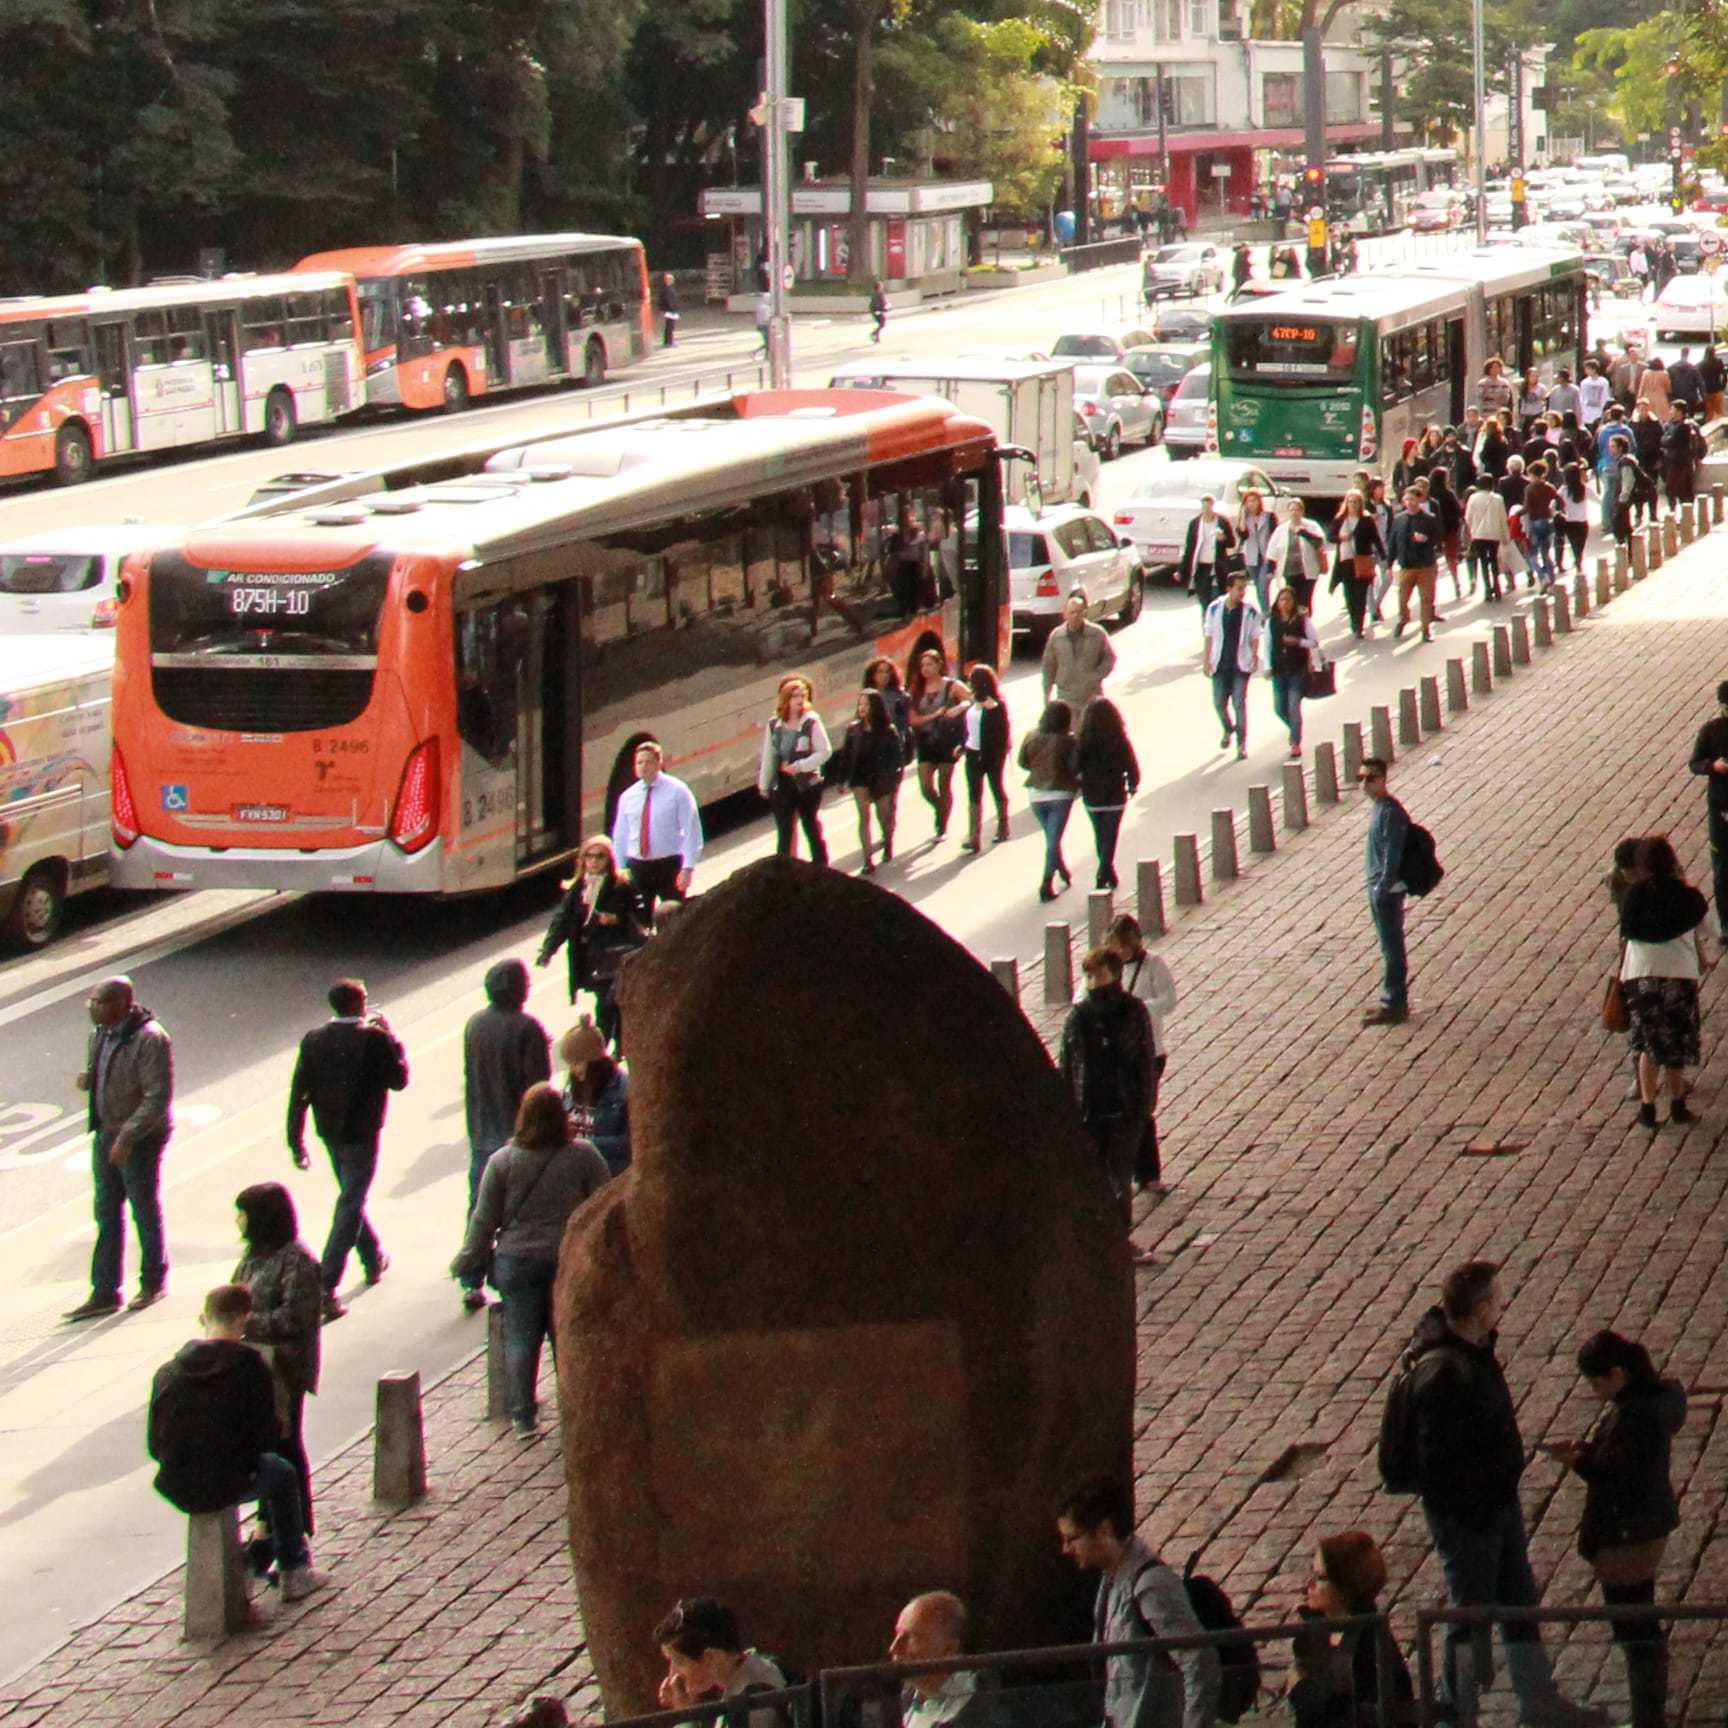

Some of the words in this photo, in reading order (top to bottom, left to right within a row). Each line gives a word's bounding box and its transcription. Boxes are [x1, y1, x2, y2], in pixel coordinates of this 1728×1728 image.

[227, 574, 244, 583] AR
[247, 573, 336, 584] CONDICIONADO
[232, 588, 309, 614] 875H-10
[330, 740, 369, 754] 2496
